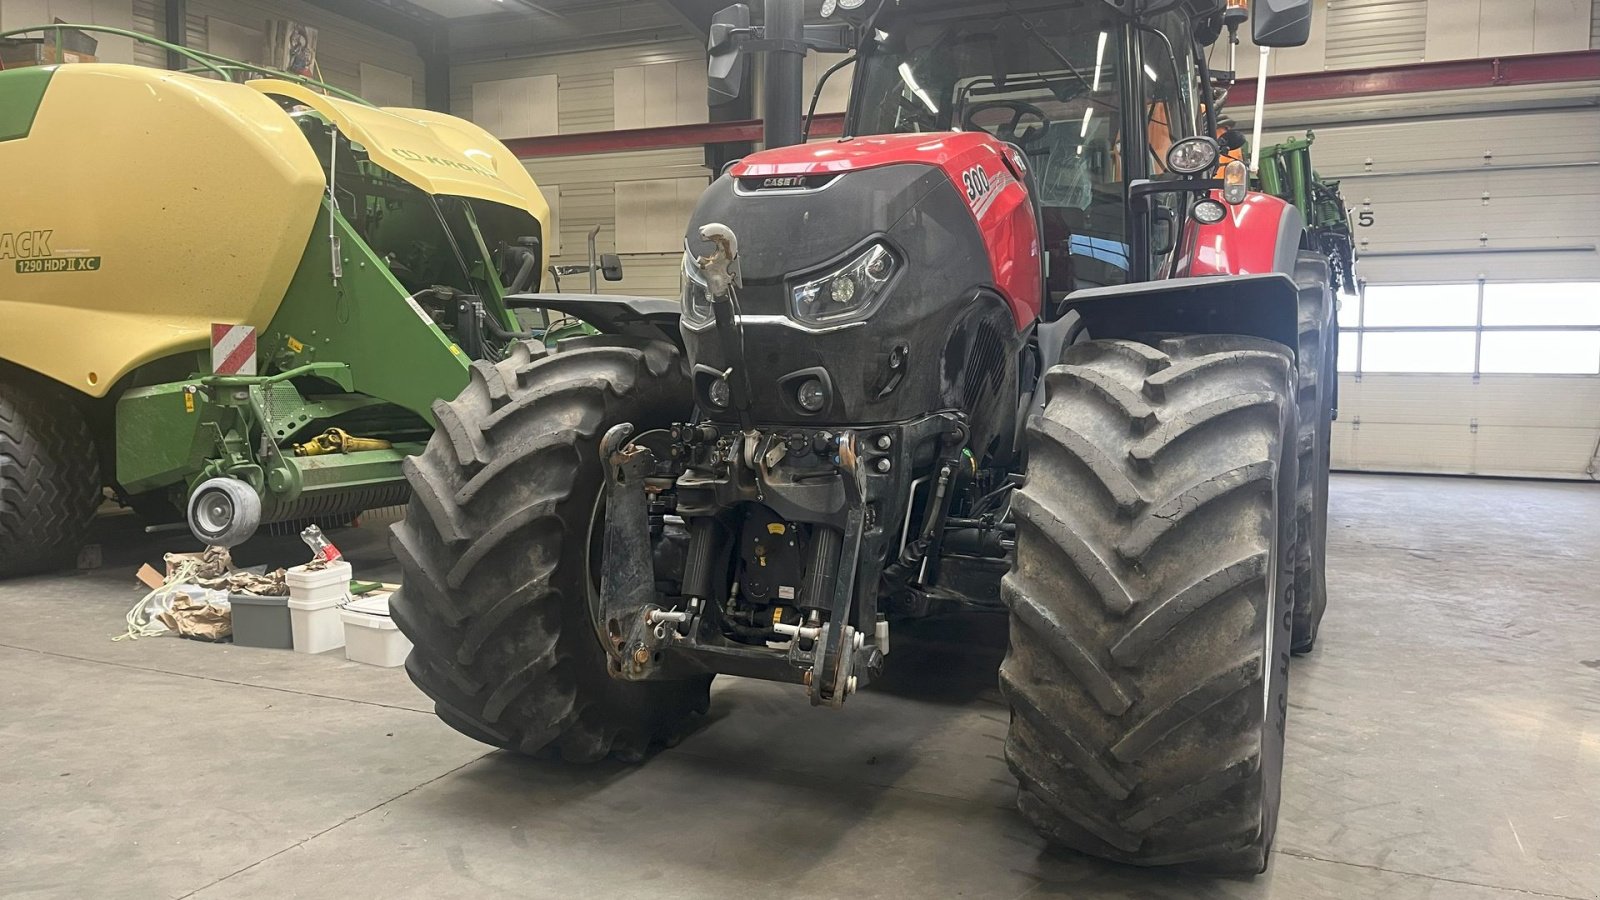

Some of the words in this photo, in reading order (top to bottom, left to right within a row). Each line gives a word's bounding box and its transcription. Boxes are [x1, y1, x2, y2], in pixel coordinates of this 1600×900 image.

[764, 177, 791, 188] CASE
[962, 165, 990, 201] 300
[1358, 211, 1375, 228] 5
[19, 260, 42, 273] 1290
[78, 258, 95, 270] XC
